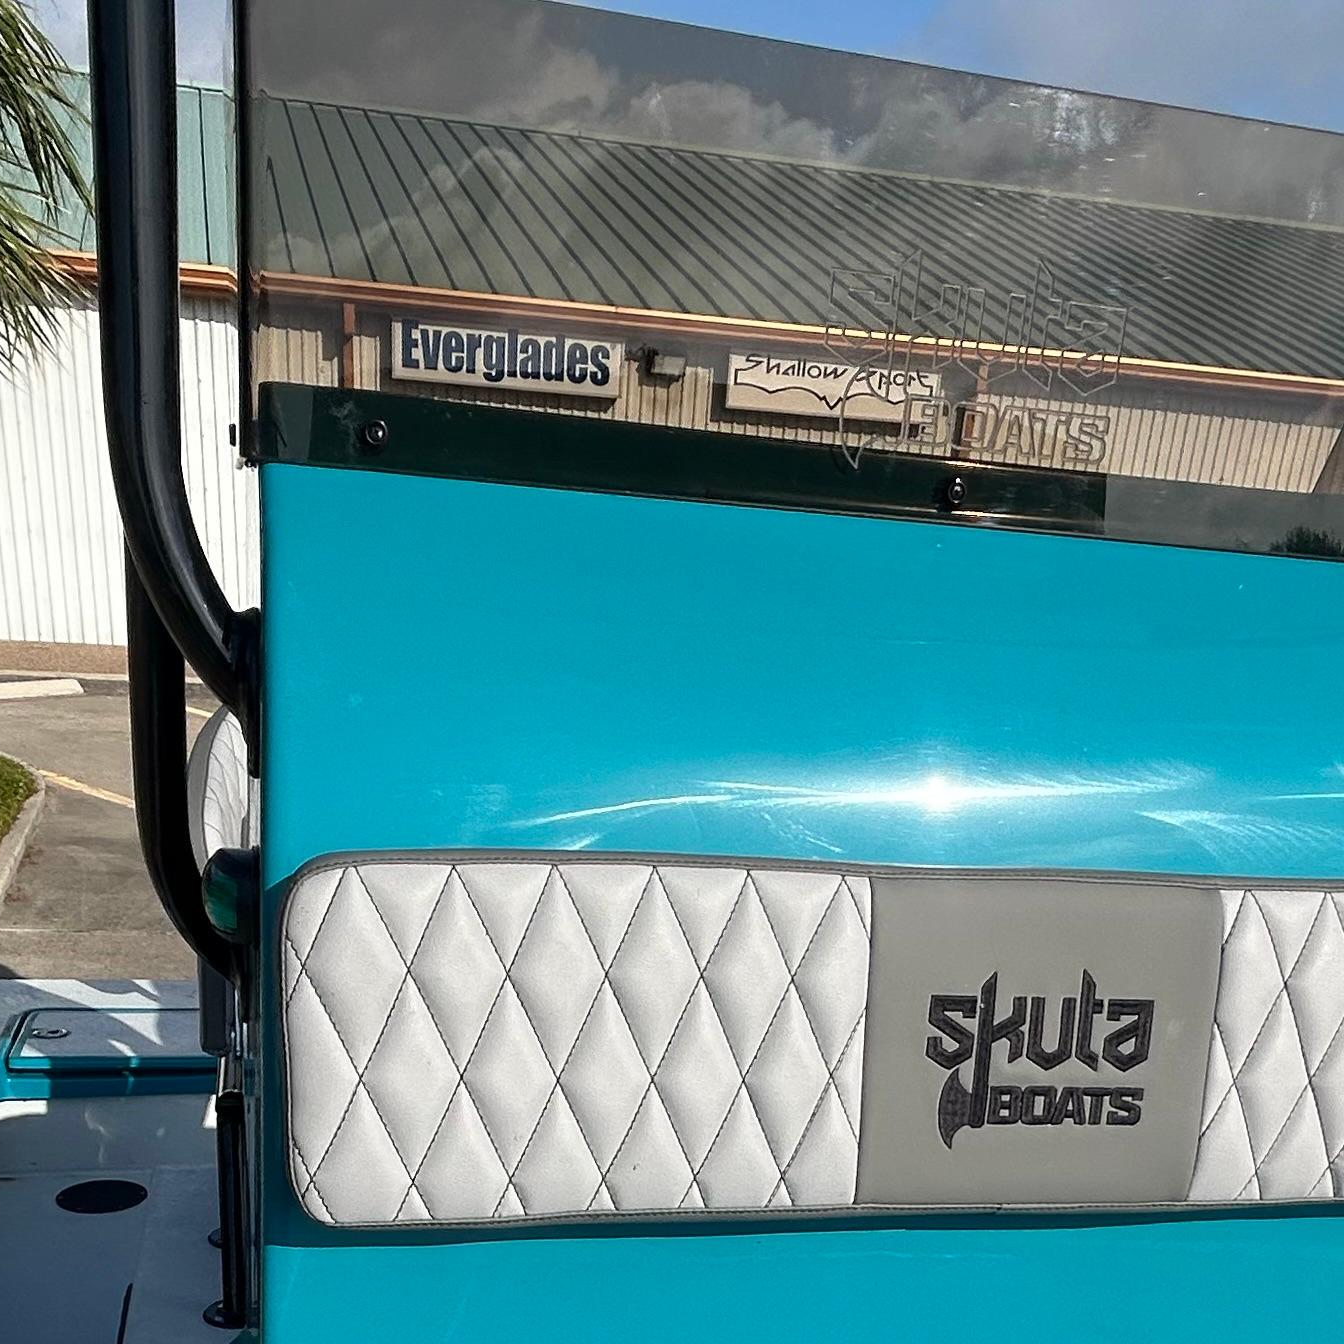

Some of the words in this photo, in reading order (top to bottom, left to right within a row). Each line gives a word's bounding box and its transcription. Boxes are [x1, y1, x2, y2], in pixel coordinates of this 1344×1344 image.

[401, 319, 611, 386] Everglades
[745, 353, 848, 380] Shallow
[903, 394, 1110, 464] BOATS
[987, 1086, 1145, 1126] BOATS
